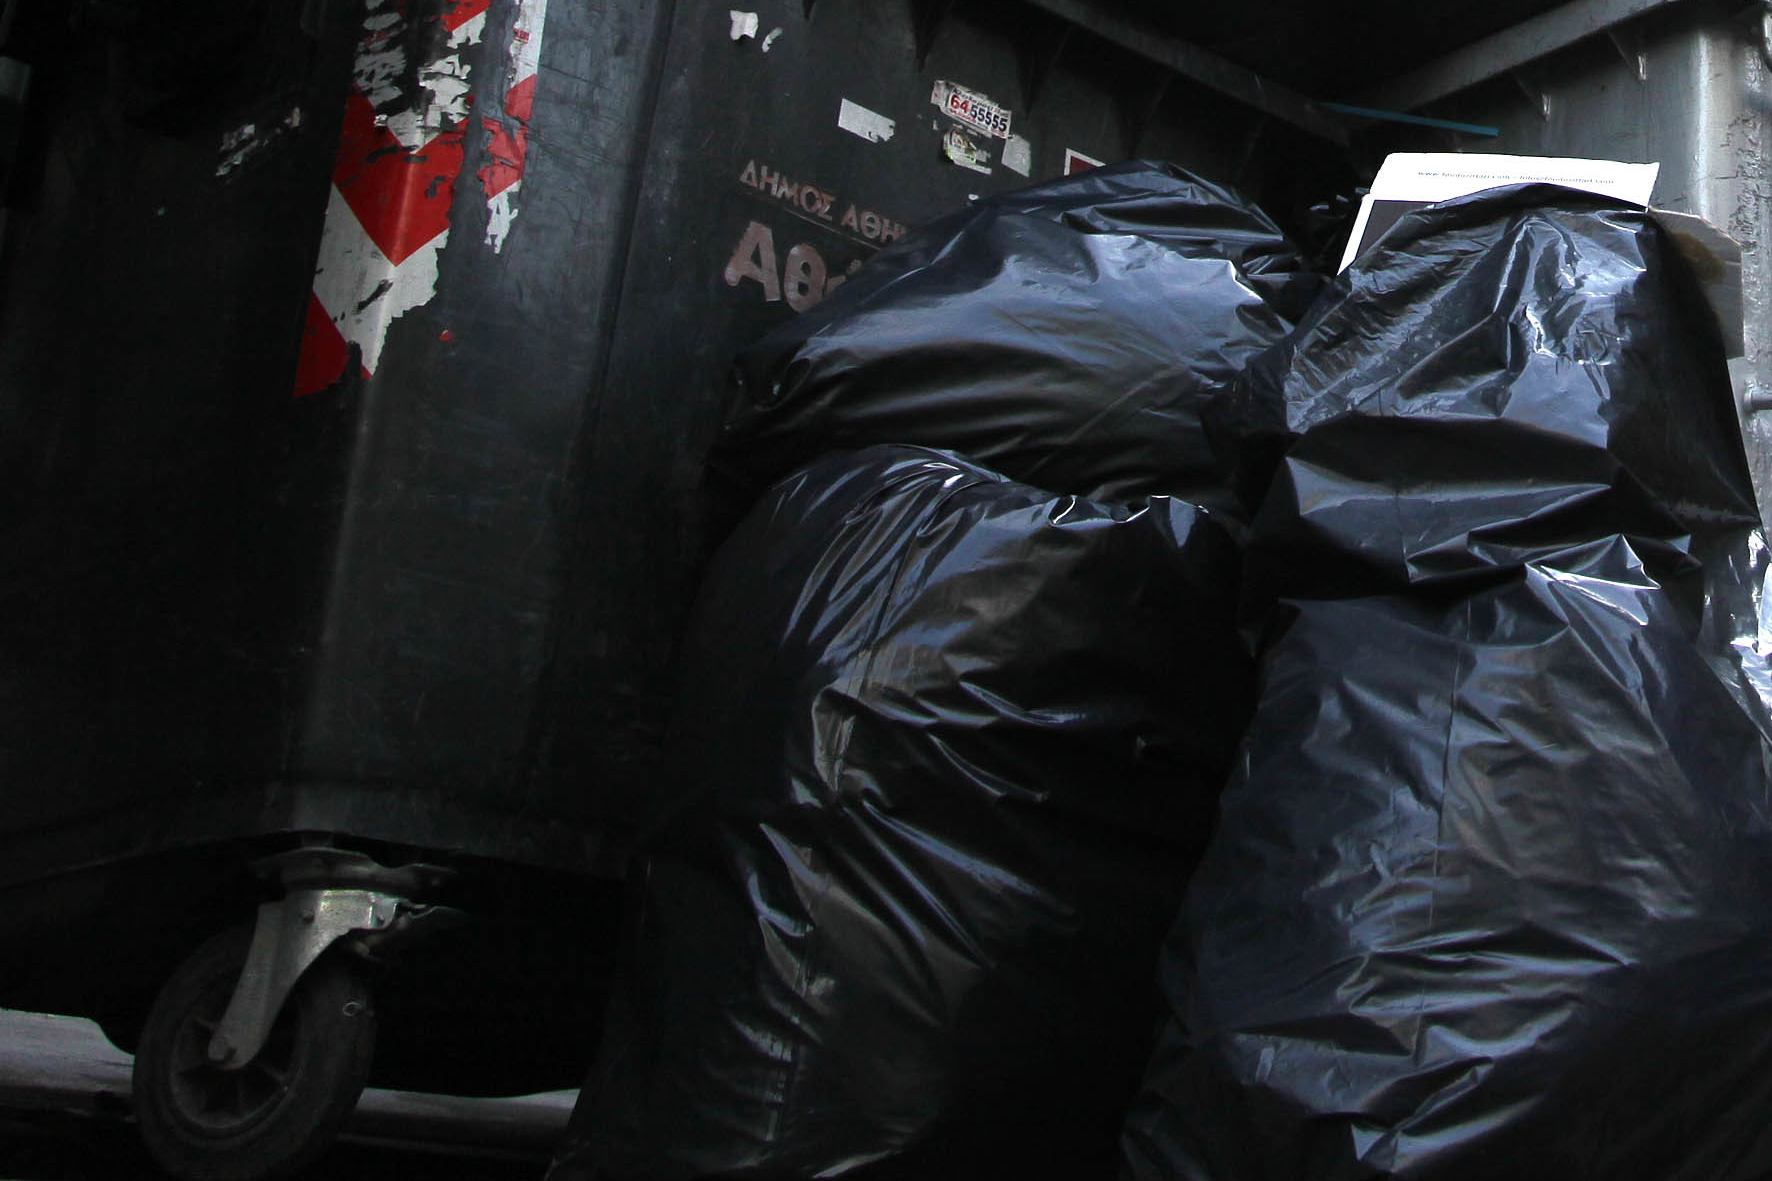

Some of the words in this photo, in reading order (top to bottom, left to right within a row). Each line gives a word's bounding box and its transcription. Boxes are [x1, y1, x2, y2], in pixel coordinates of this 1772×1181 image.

[950, 94, 1008, 132] 6455555
[739, 159, 836, 221] ΔΗΜΟΣ
[841, 204, 906, 243] ΑΘΗ
